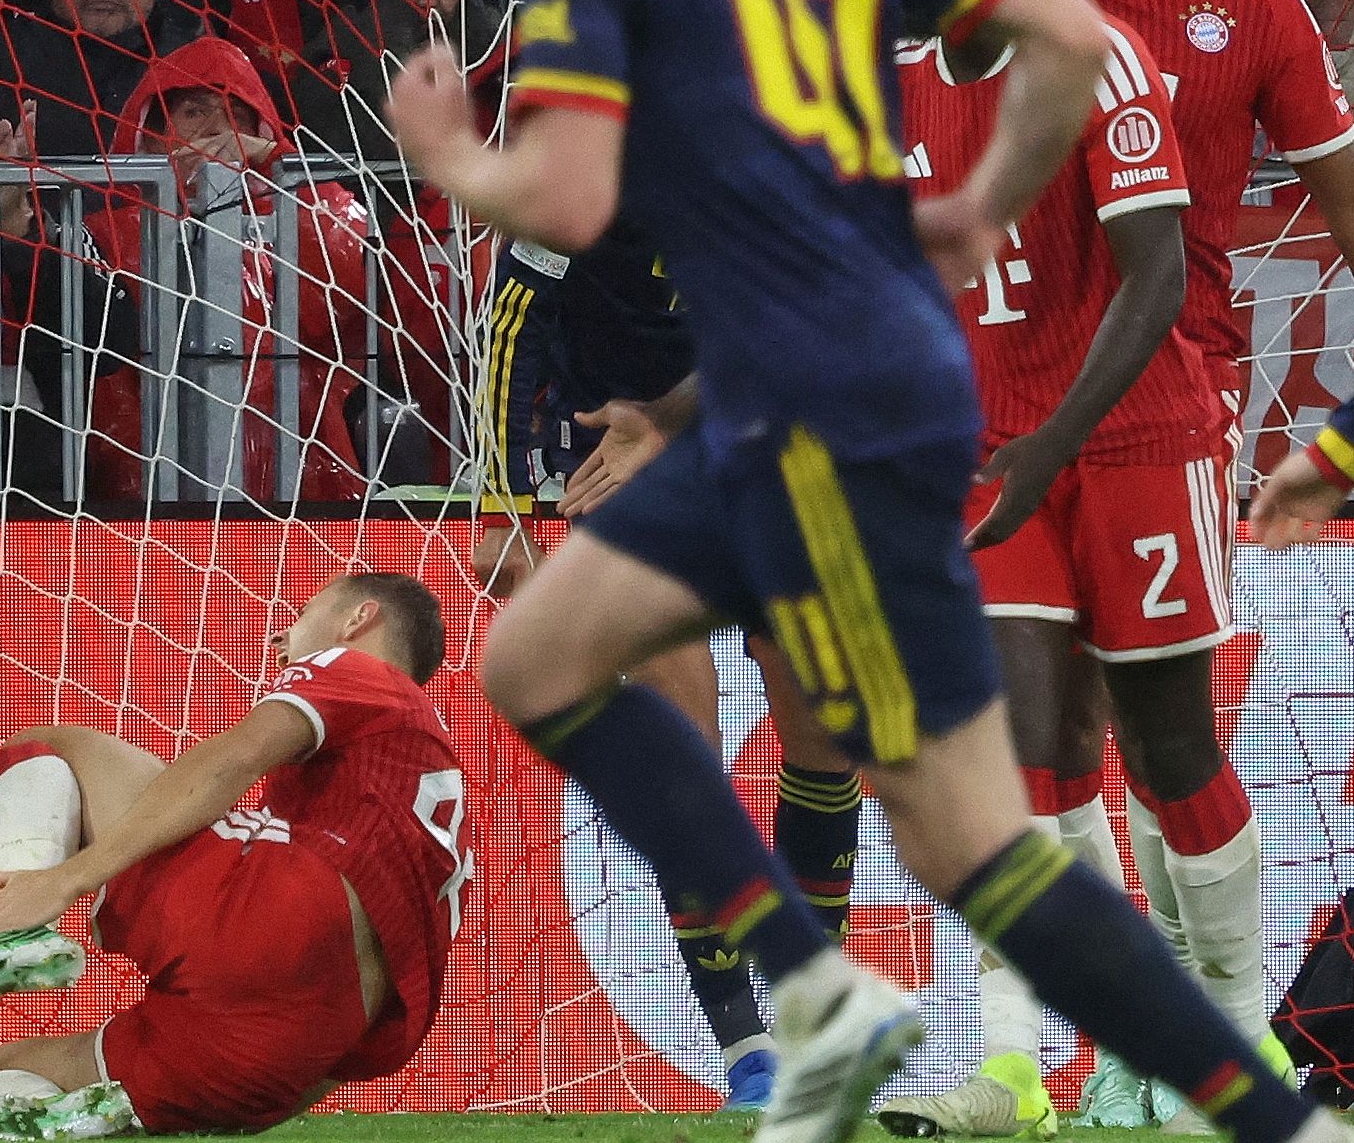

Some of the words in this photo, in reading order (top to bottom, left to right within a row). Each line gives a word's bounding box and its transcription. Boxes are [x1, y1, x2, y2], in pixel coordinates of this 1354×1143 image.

[1110, 166, 1169, 191] Allianz
[1133, 533, 1187, 620] 2
[832, 849, 858, 870] AF
